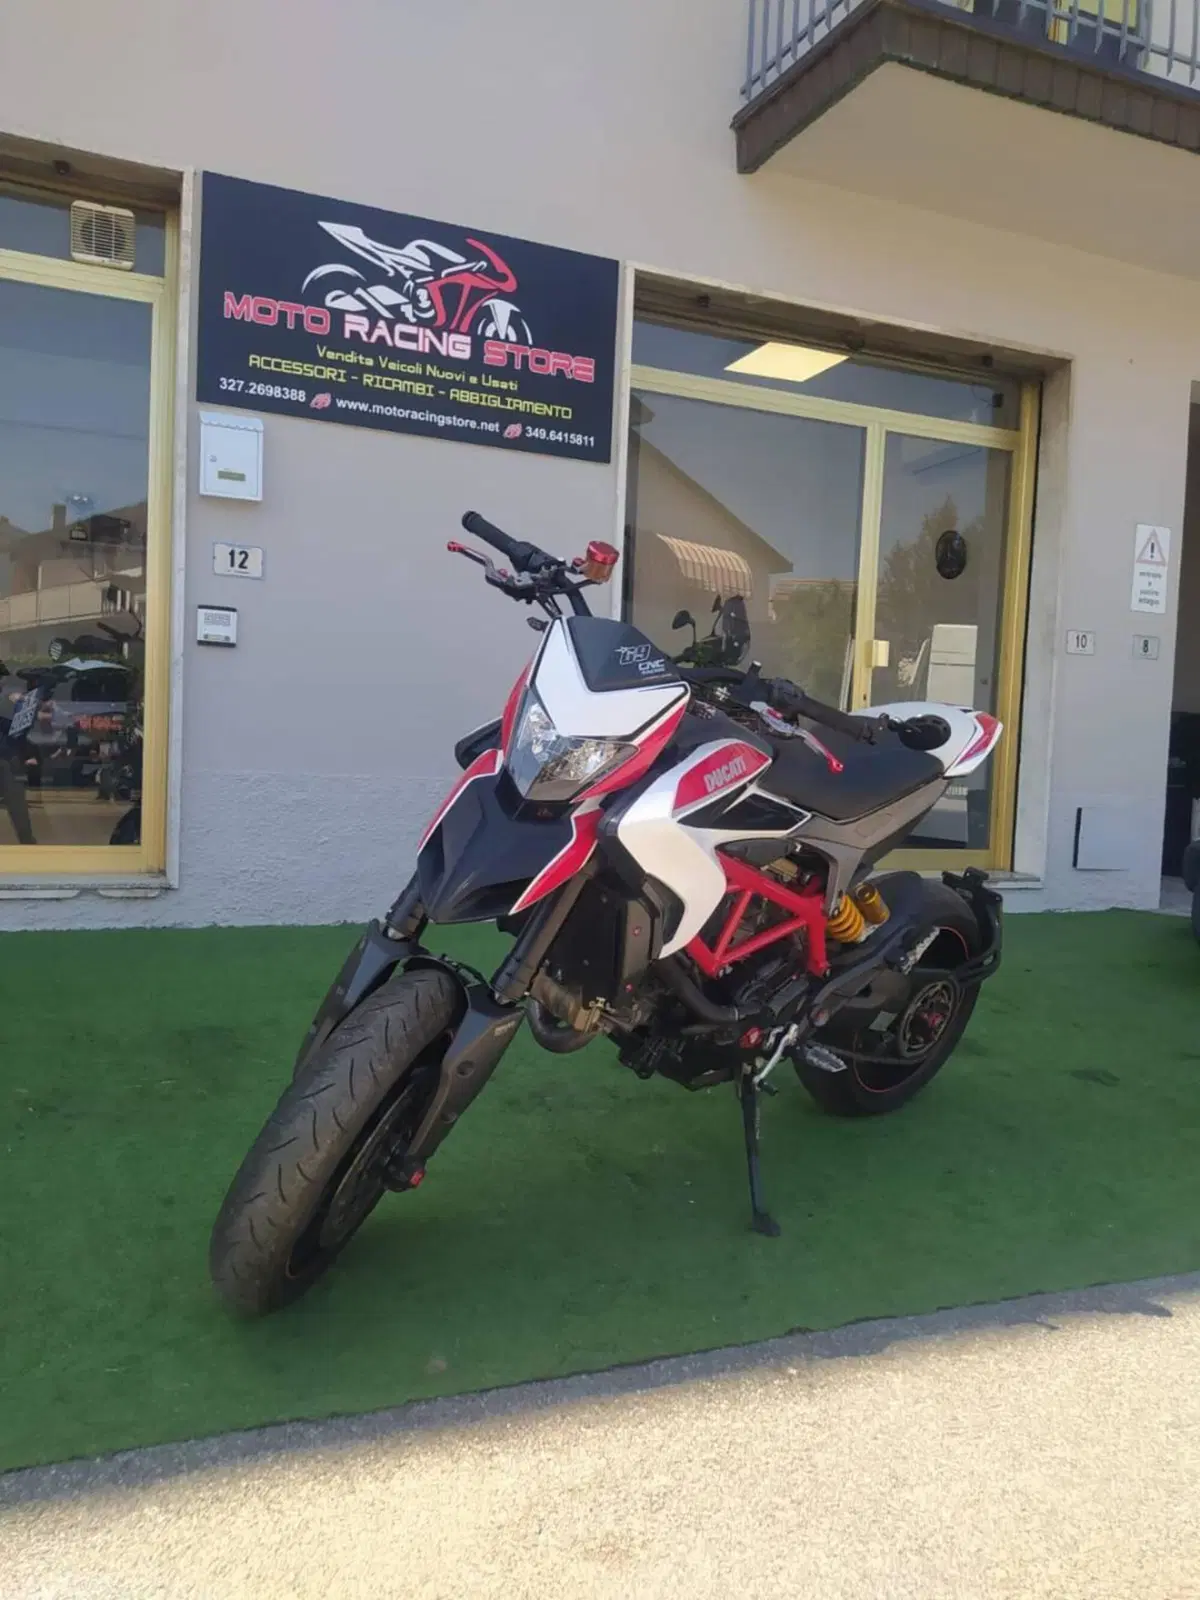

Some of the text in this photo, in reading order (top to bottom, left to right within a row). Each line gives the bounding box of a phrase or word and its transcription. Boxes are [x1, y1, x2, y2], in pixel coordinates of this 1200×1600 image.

[223, 291, 595, 382] MOTO RACING STORE
[316, 344, 518, 390] Vendita Veicoli Nuovi e Usati
[248, 354, 347, 382] ACCESSORI
[363, 374, 435, 396] RICAMBI
[449, 388, 572, 419] ABBIGLIAMENTO
[219, 377, 595, 447] 327.2698388 www.motoracingstore.net 349.6415811
[228, 549, 250, 569] 12
[1075, 634, 1087, 648] 10
[1142, 639, 1149, 653] 8
[638, 658, 665, 671] CNC
[704, 756, 747, 792] DUCATI
